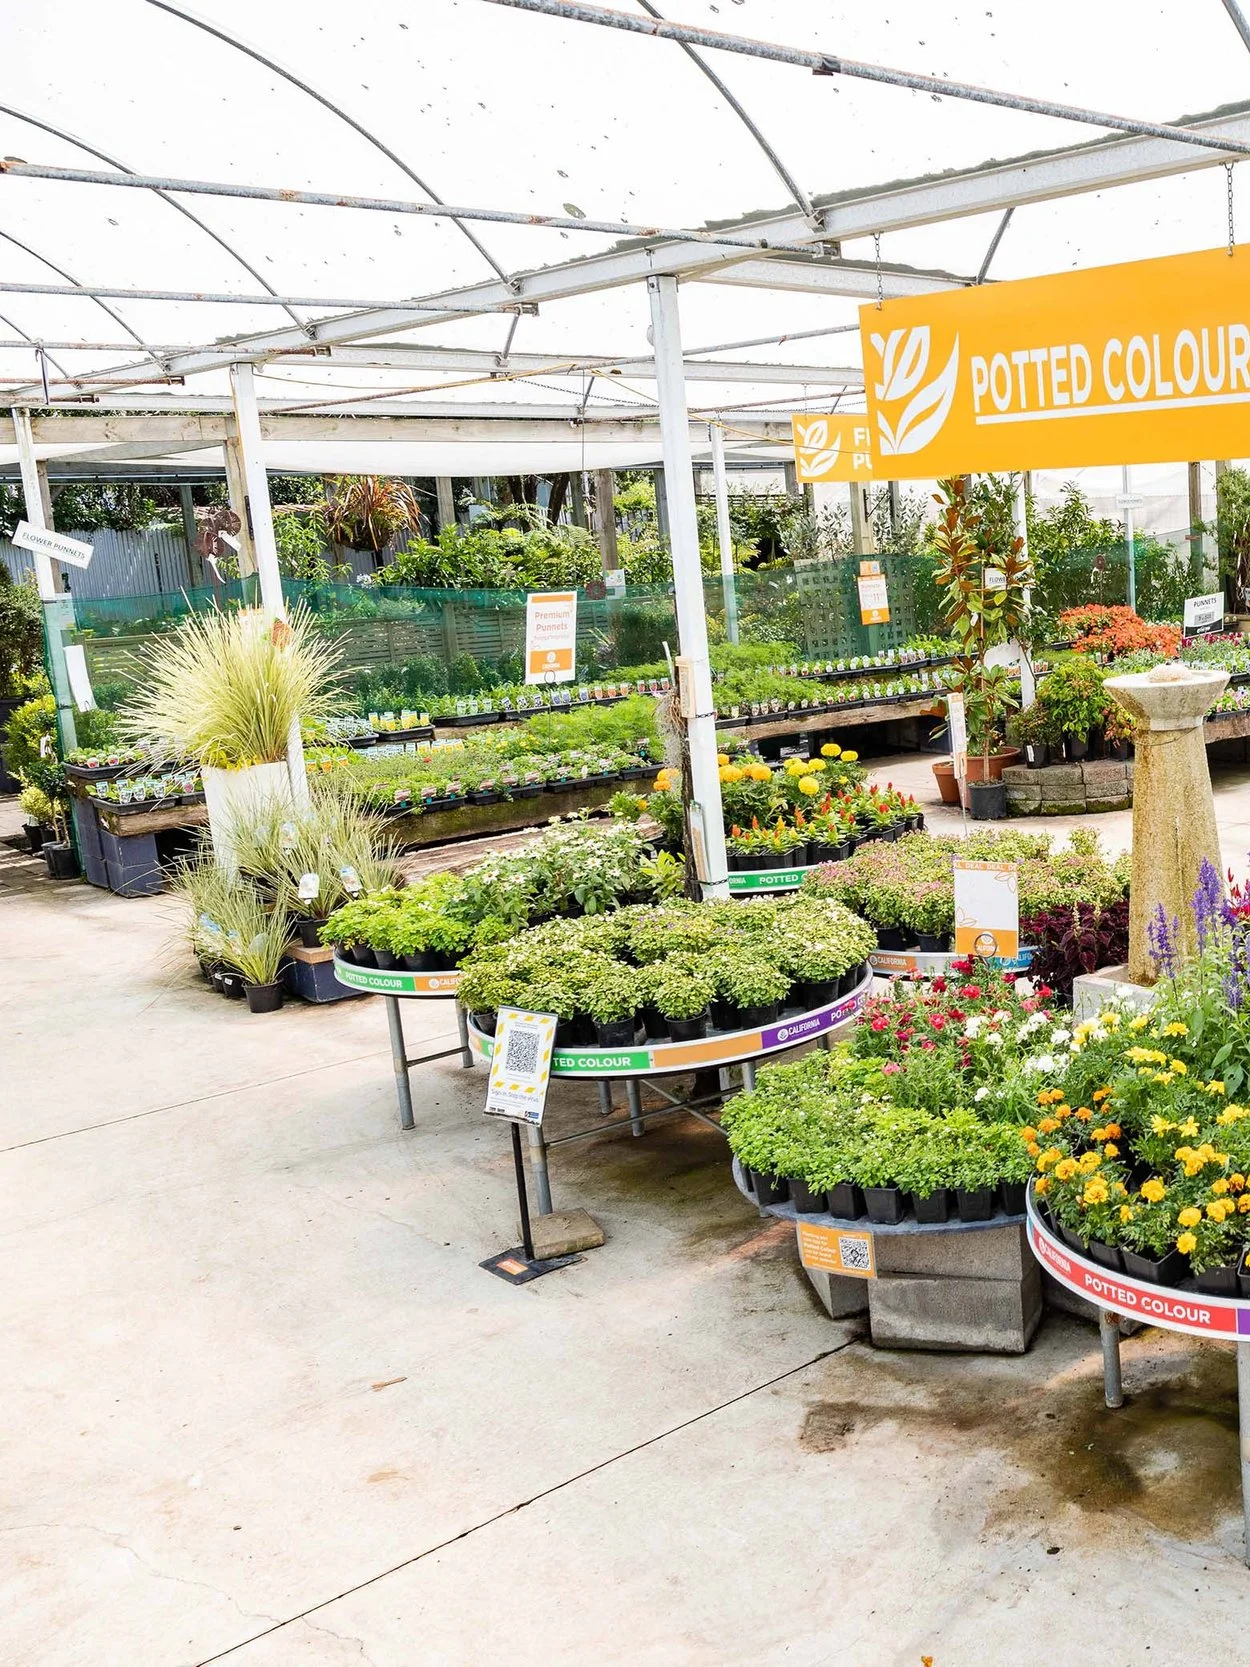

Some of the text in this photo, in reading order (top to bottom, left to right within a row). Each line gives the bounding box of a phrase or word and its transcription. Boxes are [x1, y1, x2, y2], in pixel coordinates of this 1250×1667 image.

[971, 343, 1092, 413] POTTED
[22, 532, 86, 559] FLOWER PUNNETS
[1193, 597, 1217, 608] PUNNETS
[534, 611, 570, 620] Premium
[536, 622, 568, 632] Punnets
[965, 862, 982, 870] DEAL
[986, 863, 1004, 871] DEAL
[759, 874, 799, 885] POTTED
[877, 956, 907, 966] CALIFORNIA
[345, 972, 403, 988] POTTED COLOUR
[439, 977, 462, 986] CALIFO
[788, 1018, 820, 1035] CALIFORNIA
[553, 1056, 631, 1068] TED COLOUR
[1043, 1243, 1211, 1324] CALIFORNIA POTTED COLOUR
